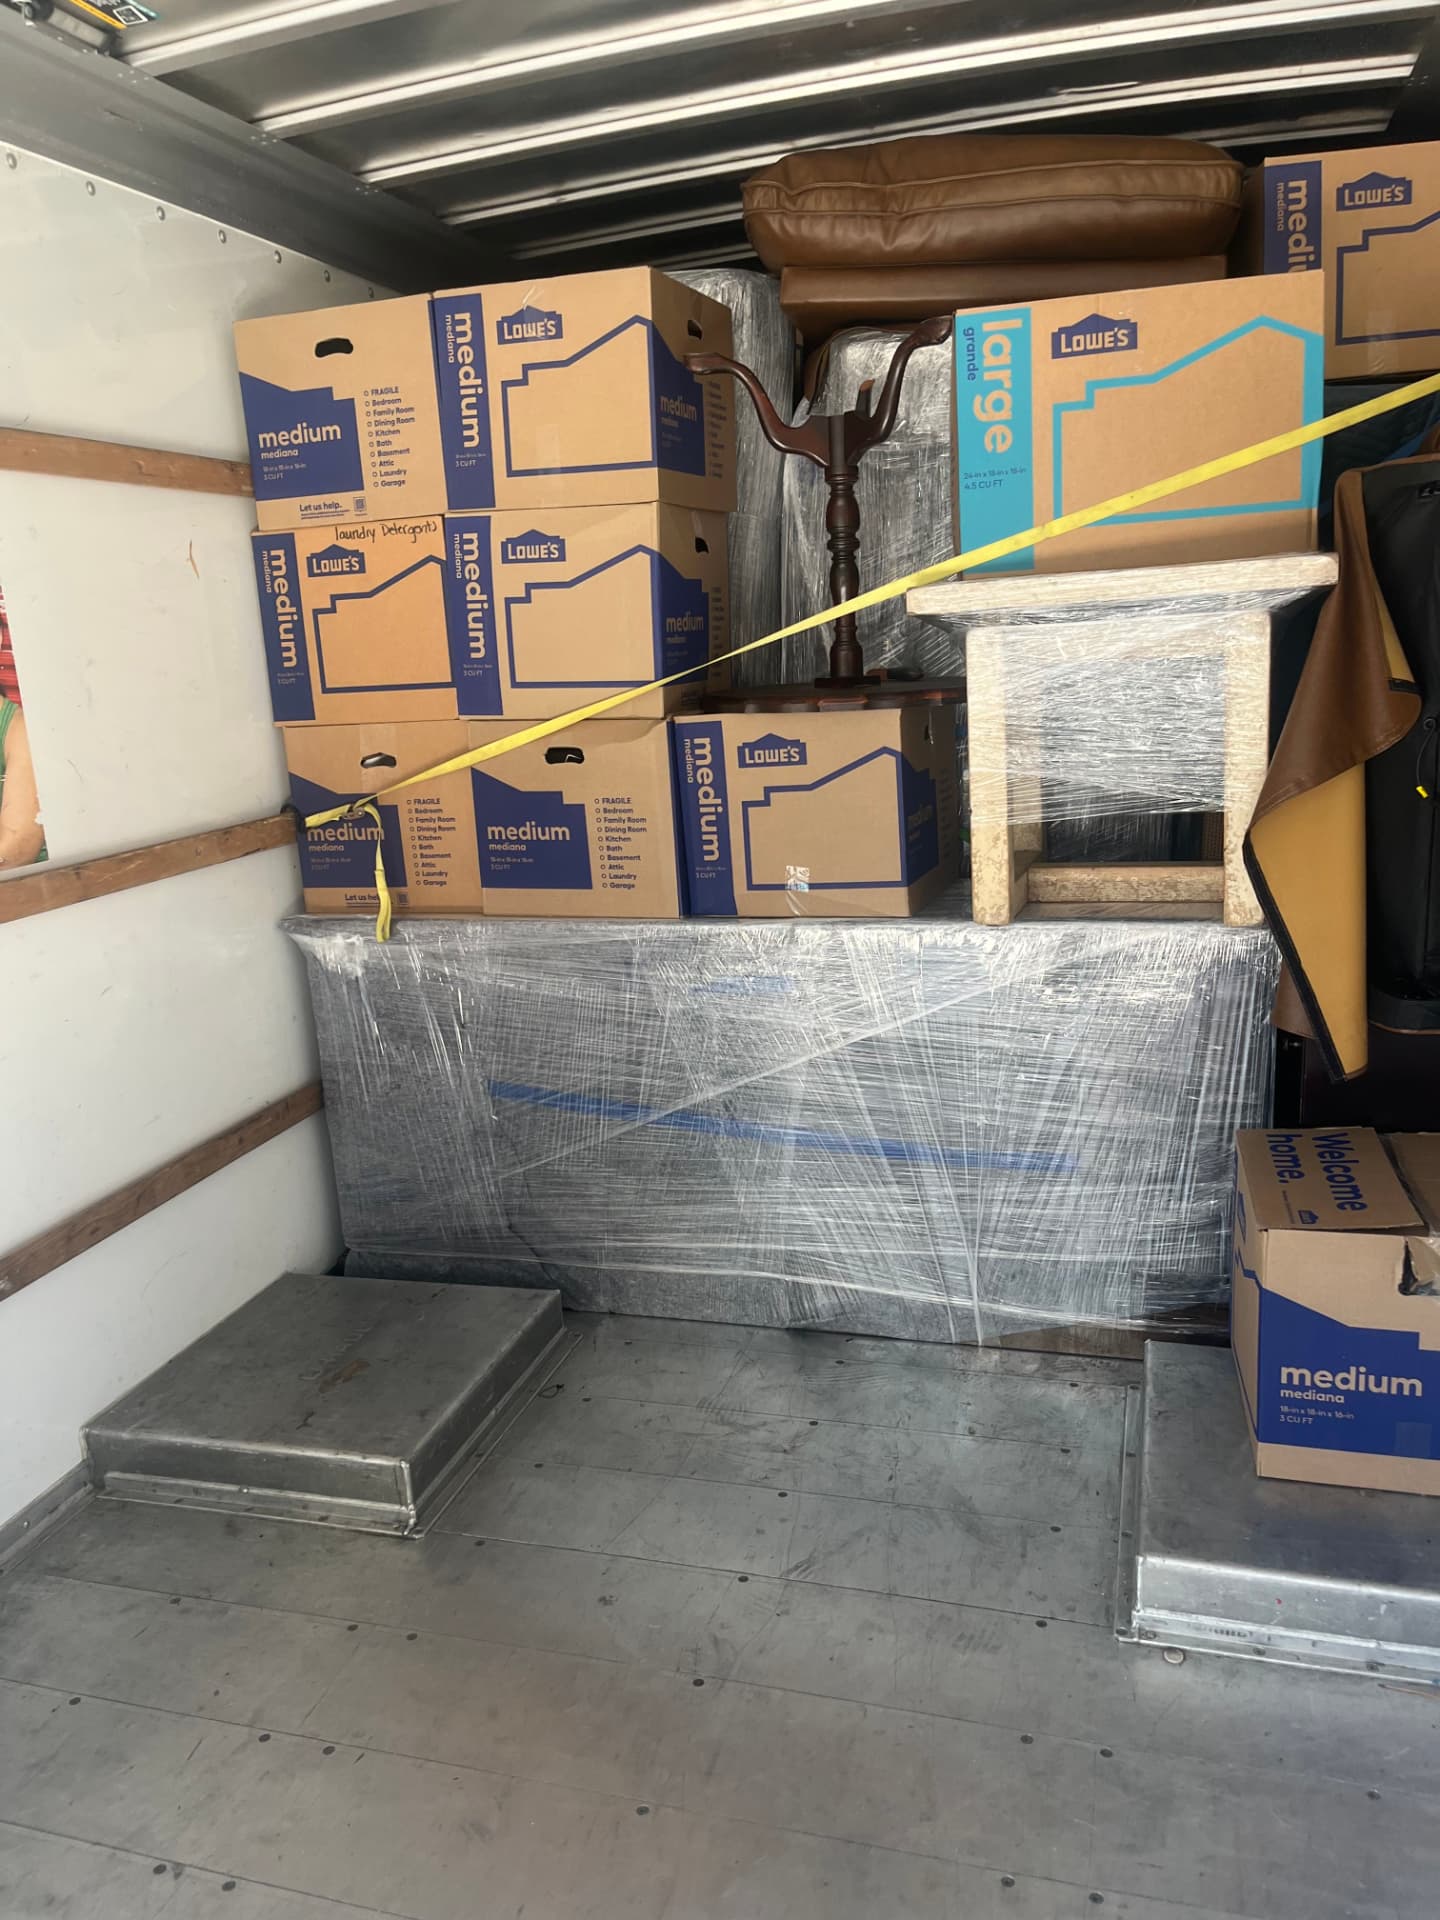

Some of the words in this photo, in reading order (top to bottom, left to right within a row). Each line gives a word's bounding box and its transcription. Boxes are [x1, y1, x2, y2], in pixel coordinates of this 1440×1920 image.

[1277, 183, 1285, 231] mediana
[1344, 185, 1404, 206] LOWE'S
[1287, 179, 1315, 273] medi
[444, 315, 454, 363] mediana
[503, 319, 557, 340] LOWE'S
[1060, 329, 1128, 353] LOWE'S
[963, 327, 979, 381] grande
[455, 312, 484, 448] medium
[973, 319, 1023, 454] large
[258, 422, 341, 448] medium
[261, 449, 299, 460] mediana
[453, 534, 463, 580] mediana
[507, 542, 560, 560] LOWE'S
[262, 551, 271, 593] mediana
[312, 556, 360, 574] LOWE'S
[270, 549, 298, 668] medium
[463, 533, 489, 659] medium
[684, 739, 694, 783] mediana
[745, 746, 800, 763] LOWE'S
[694, 737, 722, 861] medium
[307, 822, 385, 841] medium
[487, 821, 571, 841] medium
[604, 816, 626, 825] Family
[604, 826, 626, 834] Dining
[308, 843, 345, 852] mediana
[488, 843, 526, 851] mediana
[609, 873, 637, 881] Laundry
[1266, 1133, 1305, 1184] home.
[1312, 1132, 1368, 1211] Welcome
[1281, 1366, 1423, 1397] medium
[1280, 1388, 1345, 1403] mediana
